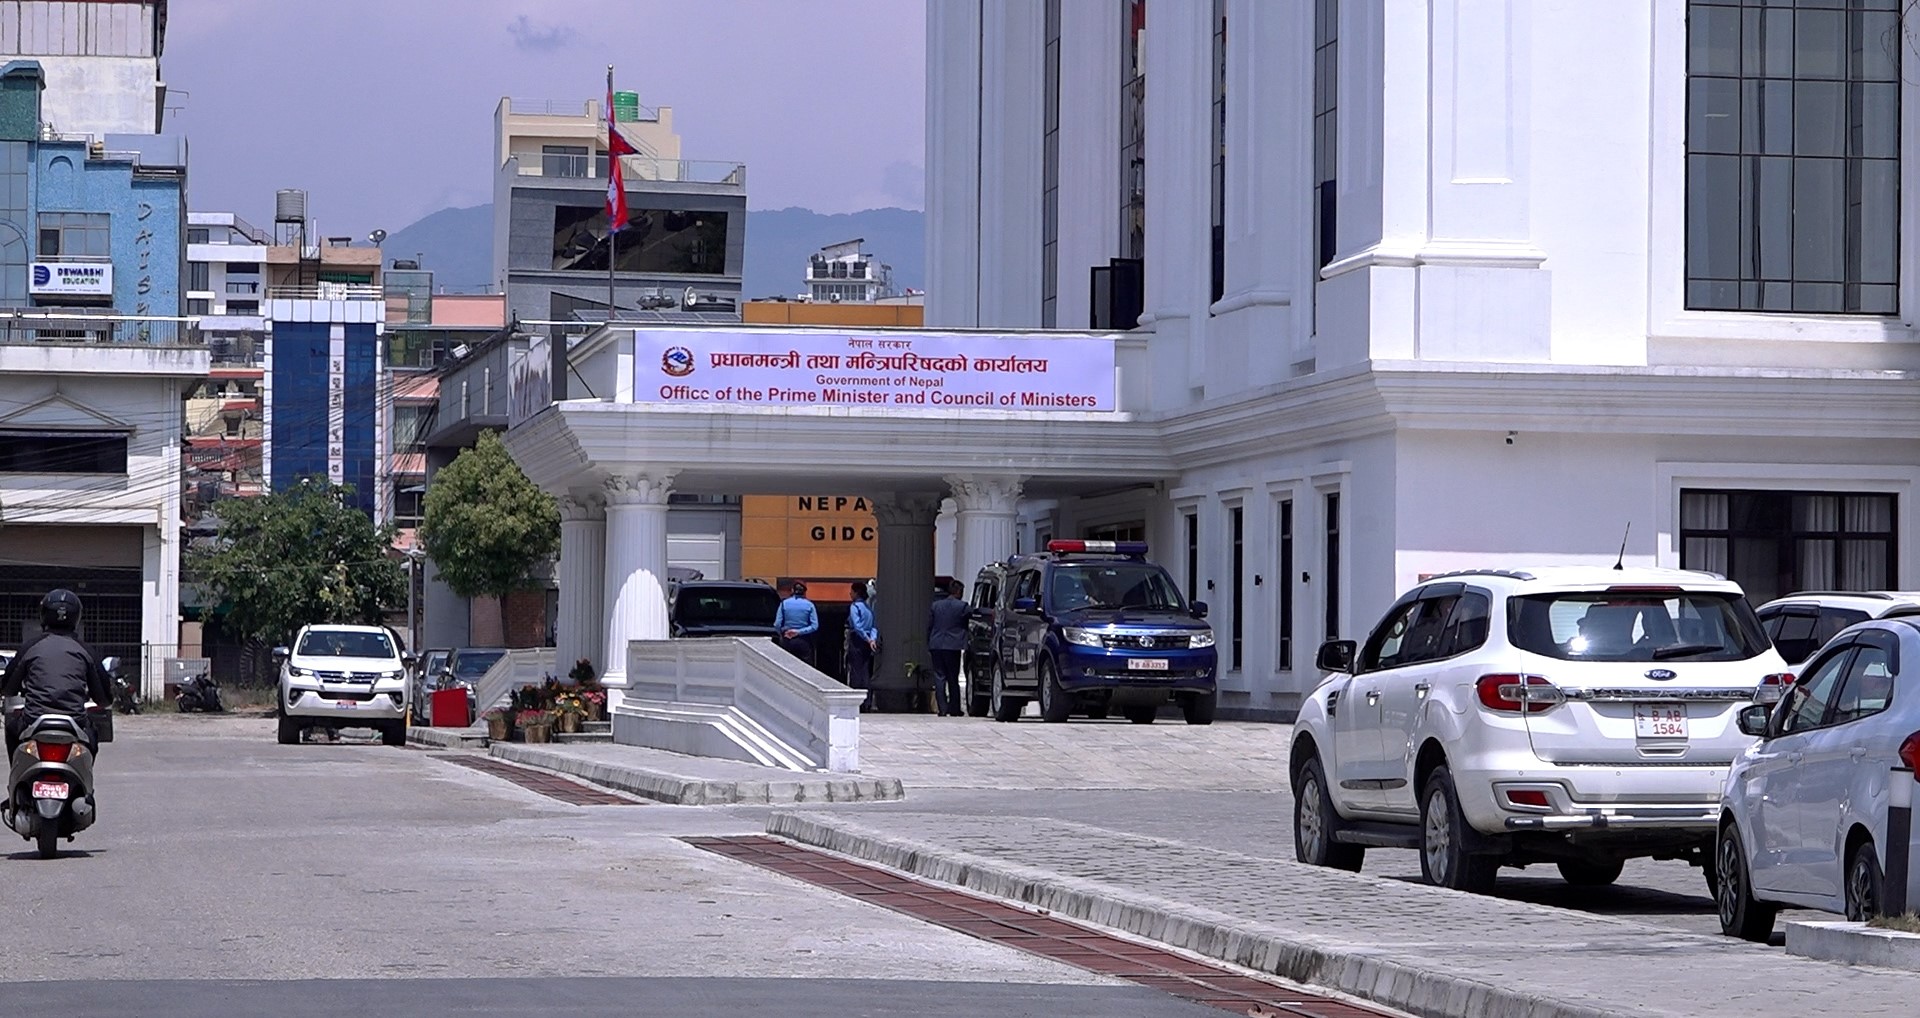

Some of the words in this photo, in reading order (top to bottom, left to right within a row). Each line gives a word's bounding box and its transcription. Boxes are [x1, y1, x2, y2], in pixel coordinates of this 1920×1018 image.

[57, 268, 104, 277] DEWARSHI
[62, 277, 100, 285] EDUCATION
[848, 337, 873, 349] नेपाल
[878, 339, 912, 350] सरकार
[710, 350, 801, 369] प्रधानमन्त्री
[807, 354, 841, 369] तथा
[846, 351, 967, 373] मन्त्रिपरिषदको
[973, 355, 1048, 373] कार्यालय
[816, 374, 891, 386] Government
[894, 376, 907, 387] of
[909, 377, 944, 389] Nepal
[660, 385, 711, 401] Office
[715, 386, 732, 401] of
[736, 387, 763, 401] the
[768, 388, 816, 402] Prime
[822, 388, 889, 403] Minister
[895, 390, 925, 404] and
[931, 391, 994, 405] Council
[999, 391, 1016, 406] of
[1021, 392, 1097, 407] Ministers
[811, 526, 874, 541] GIDC
[1652, 710, 1660, 722] B
[1666, 710, 1682, 722] AB
[1653, 723, 1683, 735] 1584
